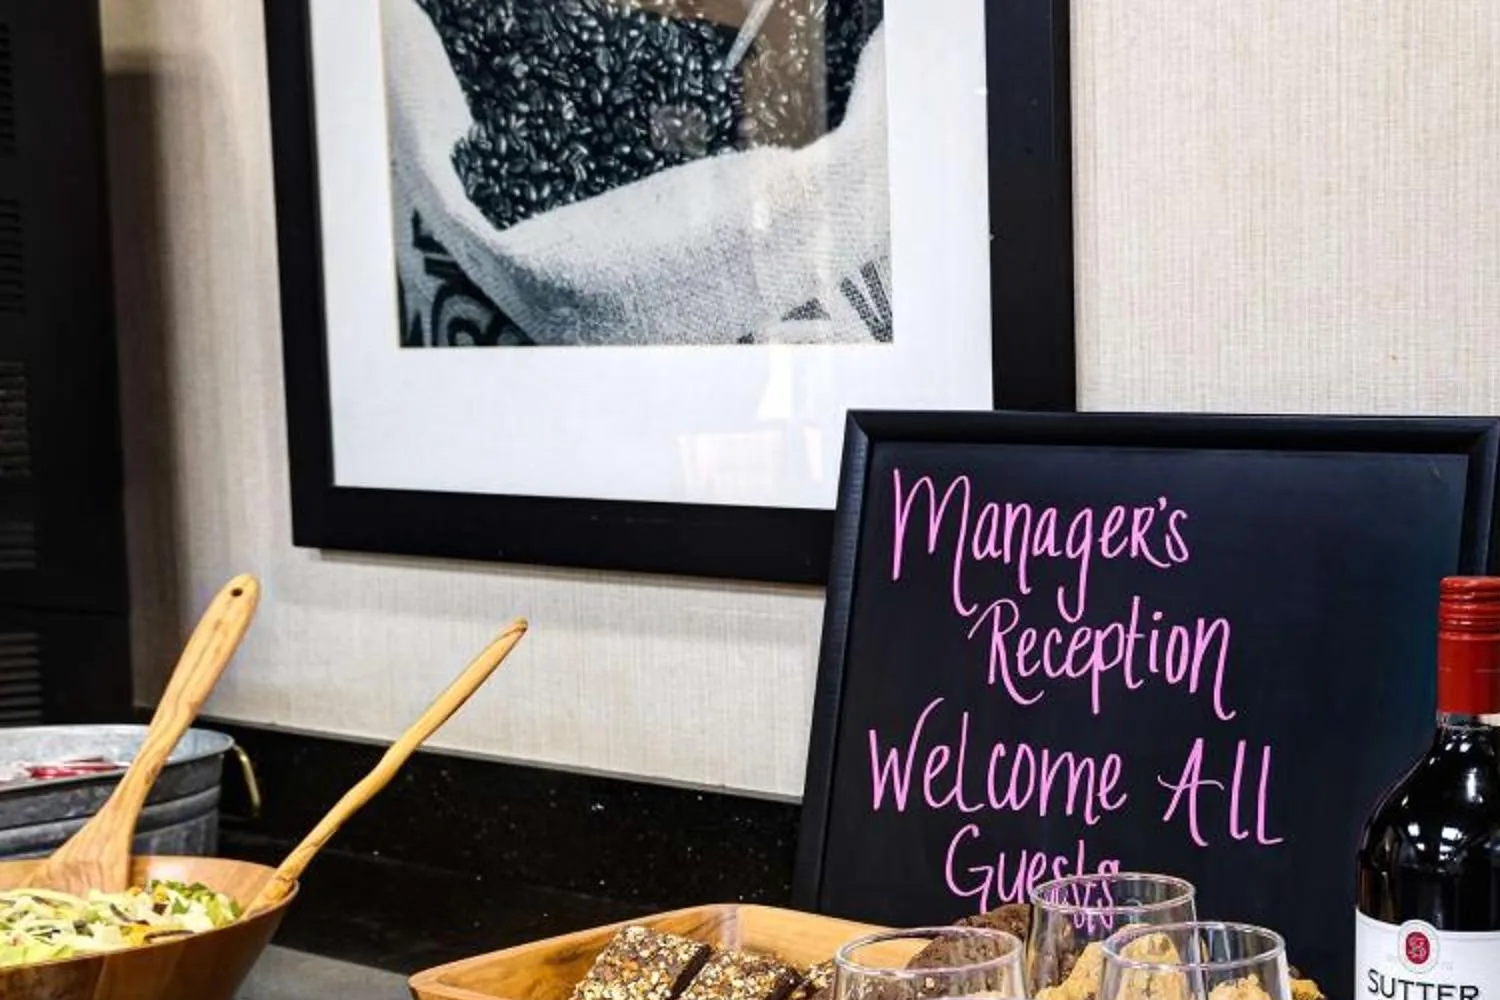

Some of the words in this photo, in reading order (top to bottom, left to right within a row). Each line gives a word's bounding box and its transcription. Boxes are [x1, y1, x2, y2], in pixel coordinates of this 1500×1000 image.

[891, 468, 1191, 624] Manager's
[966, 597, 1237, 721] Reception
[867, 697, 1128, 826] Welcome
[1156, 737, 1284, 848] All
